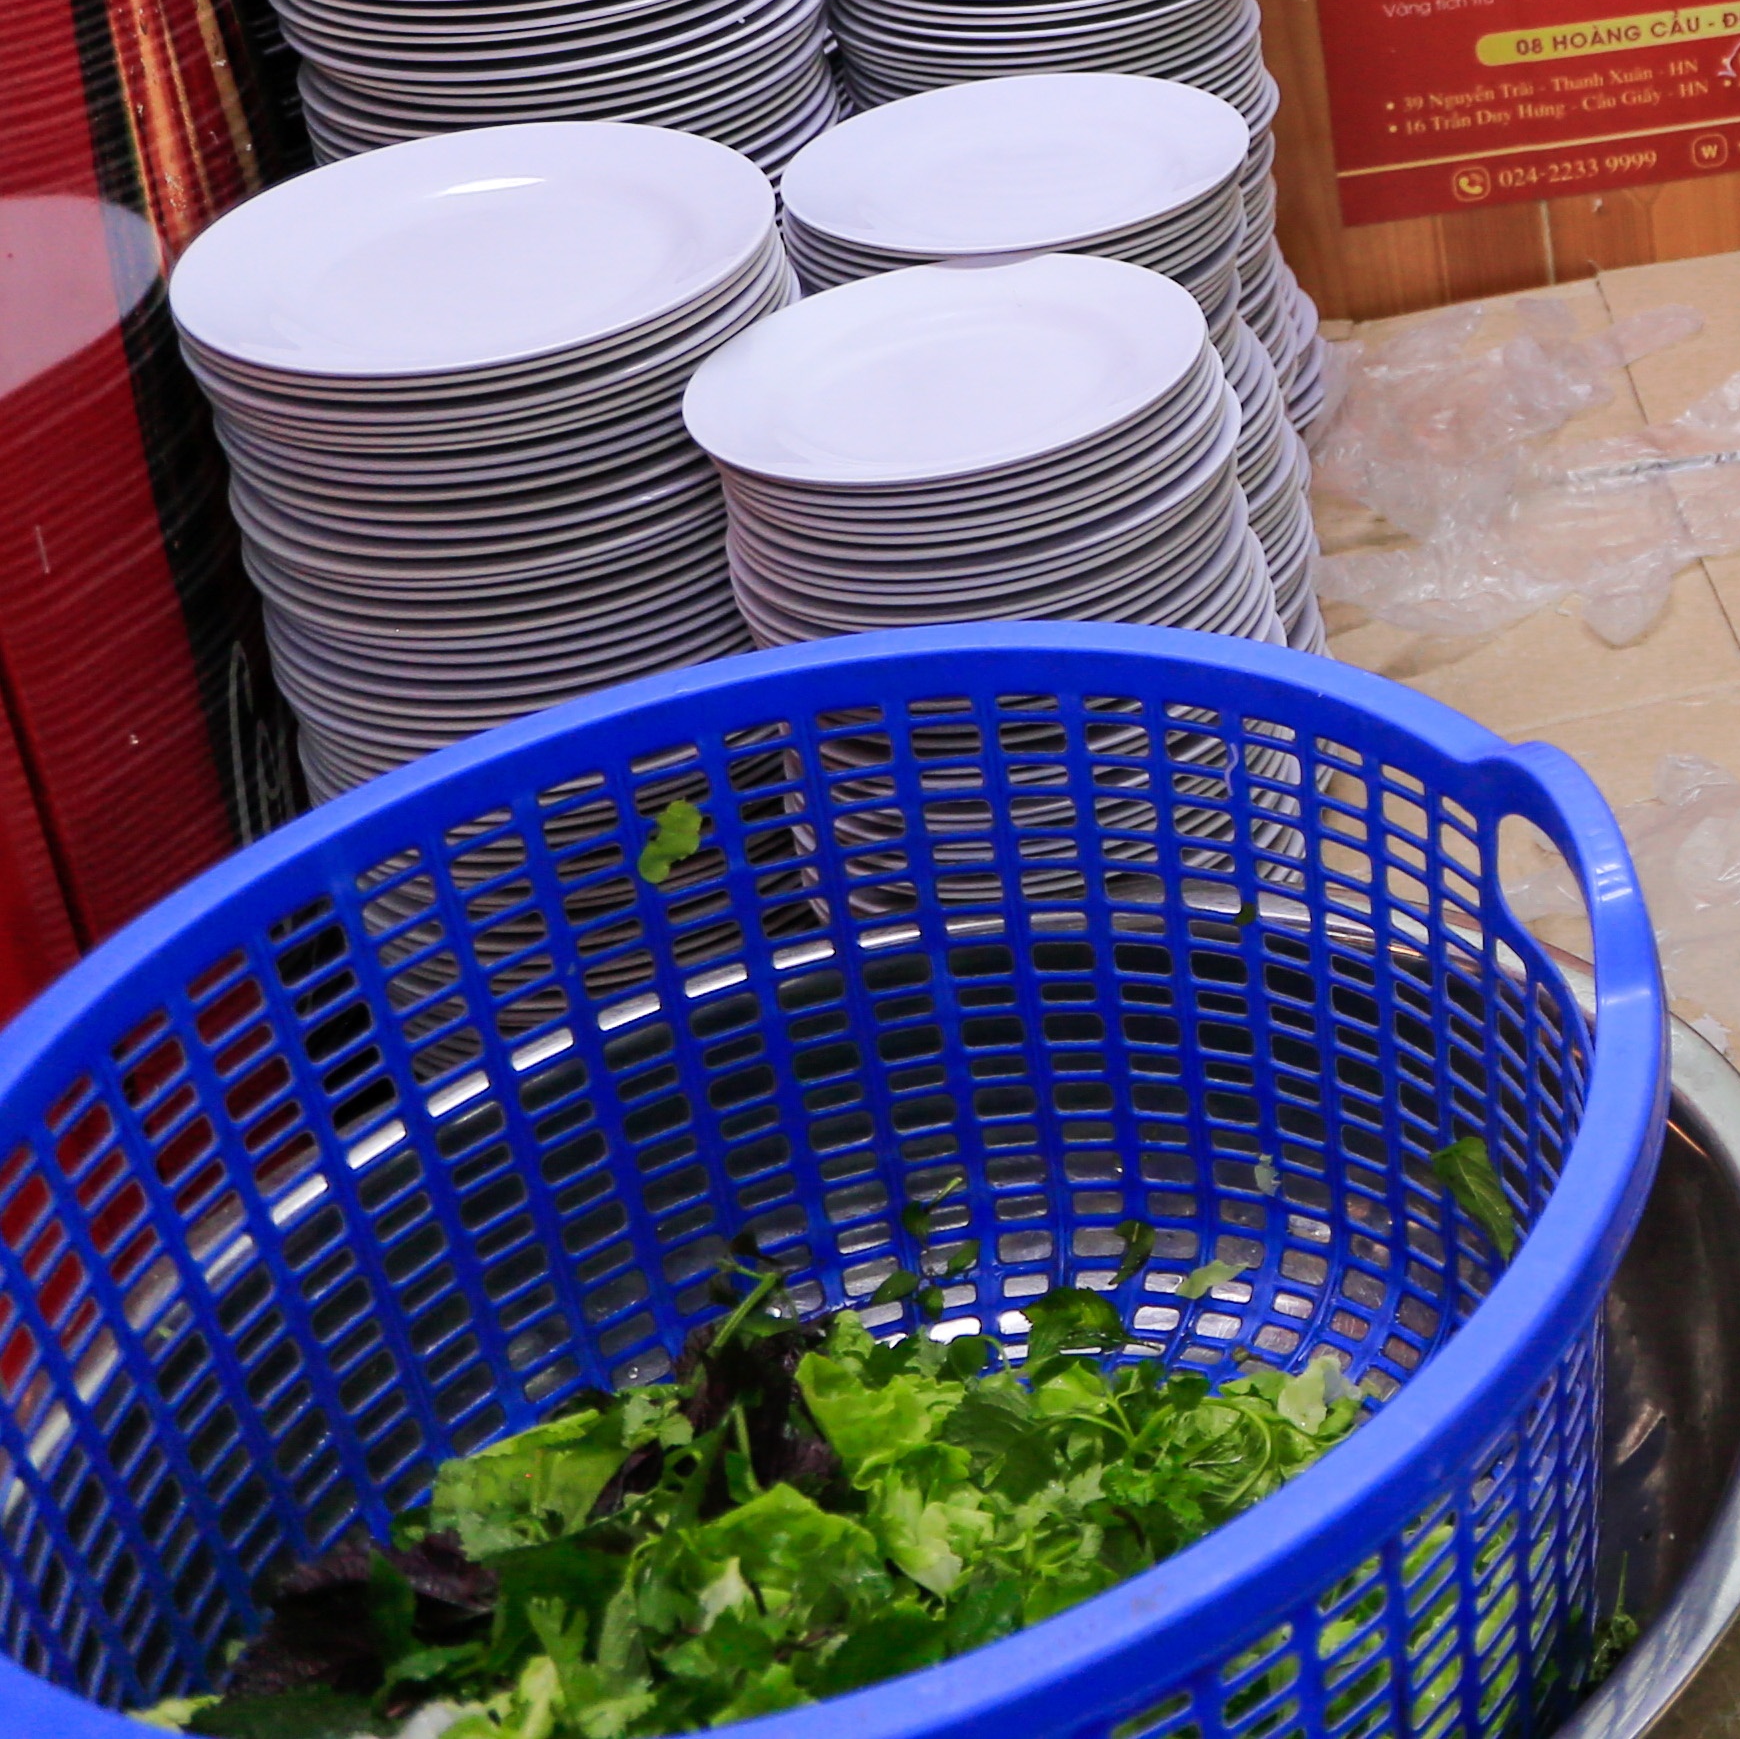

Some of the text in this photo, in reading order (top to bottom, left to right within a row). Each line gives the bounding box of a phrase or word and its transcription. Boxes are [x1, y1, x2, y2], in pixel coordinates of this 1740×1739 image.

[1516, 37, 1544, 56] 08
[1552, 23, 1642, 52] HOÀNG
[1650, 10, 1700, 37] CẦU
[1550, 77, 1604, 93] Thanh
[1668, 61, 1699, 77] HN
[1404, 120, 1426, 136] 16
[1477, 108, 1511, 127] Duy
[1679, 81, 1709, 98] HN
[1498, 150, 1657, 188] 024-2233 9999
